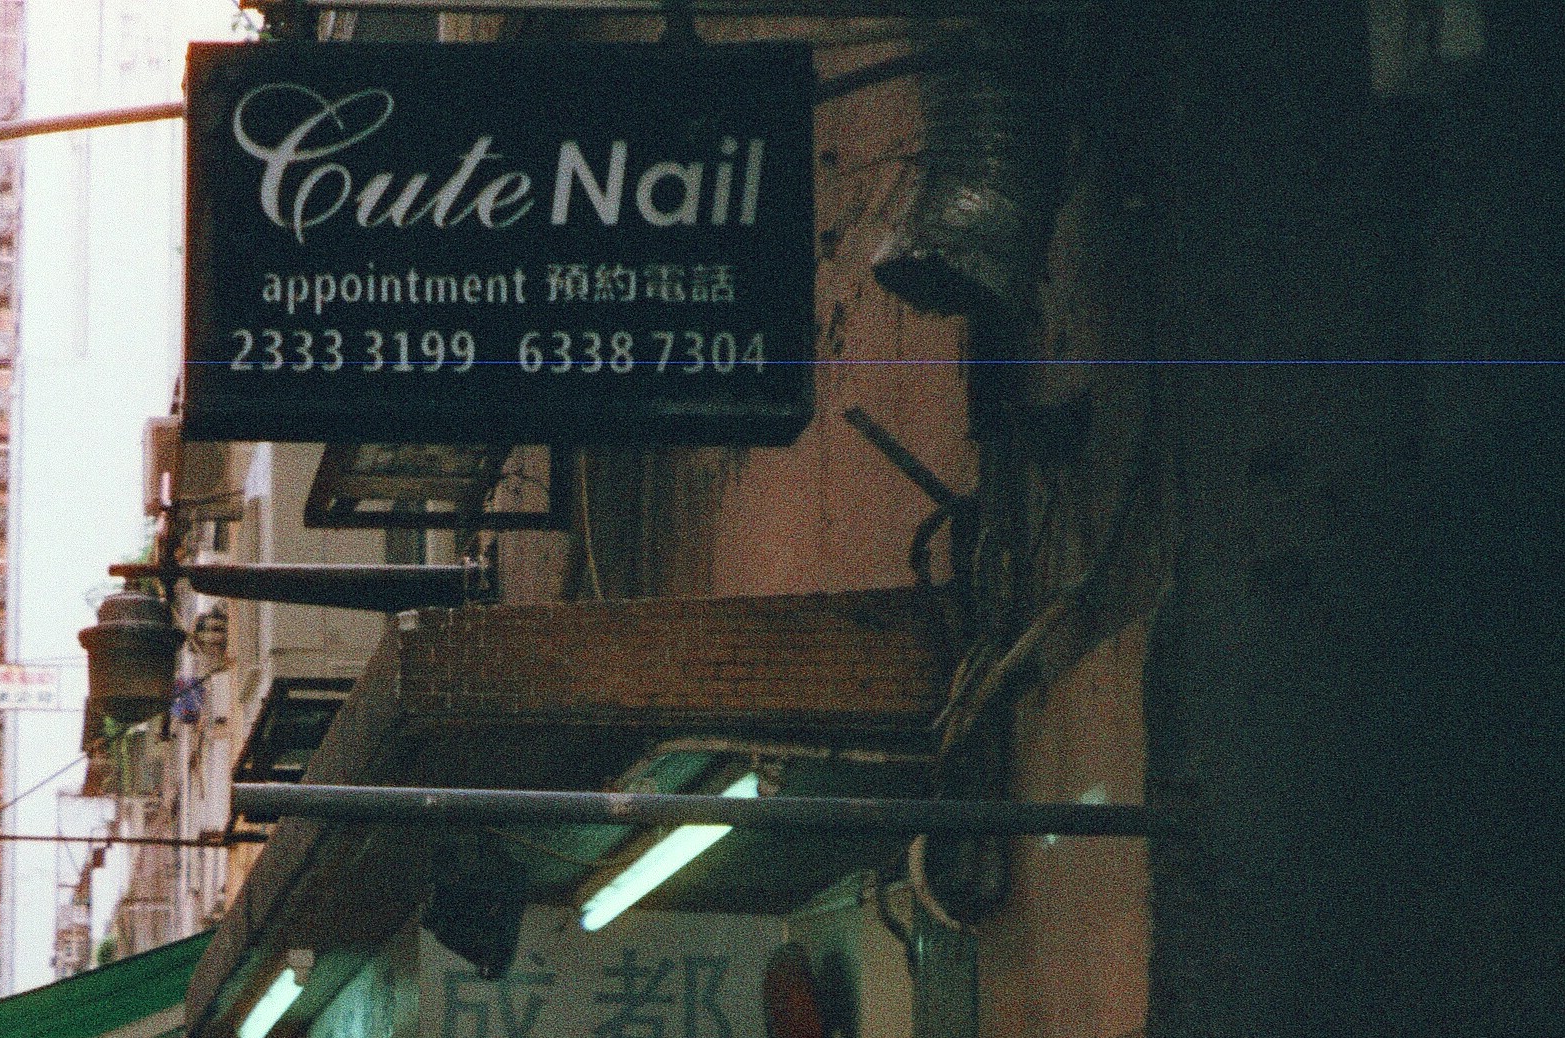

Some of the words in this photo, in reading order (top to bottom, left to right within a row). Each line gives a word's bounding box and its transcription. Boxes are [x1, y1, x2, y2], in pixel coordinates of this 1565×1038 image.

[234, 82, 533, 244] Cute
[550, 136, 765, 227] Nail
[262, 264, 526, 314] appointment
[546, 263, 735, 302] 預約電話
[231, 330, 343, 373] 2333
[363, 331, 476, 373] 3199
[518, 332, 633, 374] 6338
[652, 332, 766, 375] 7304
